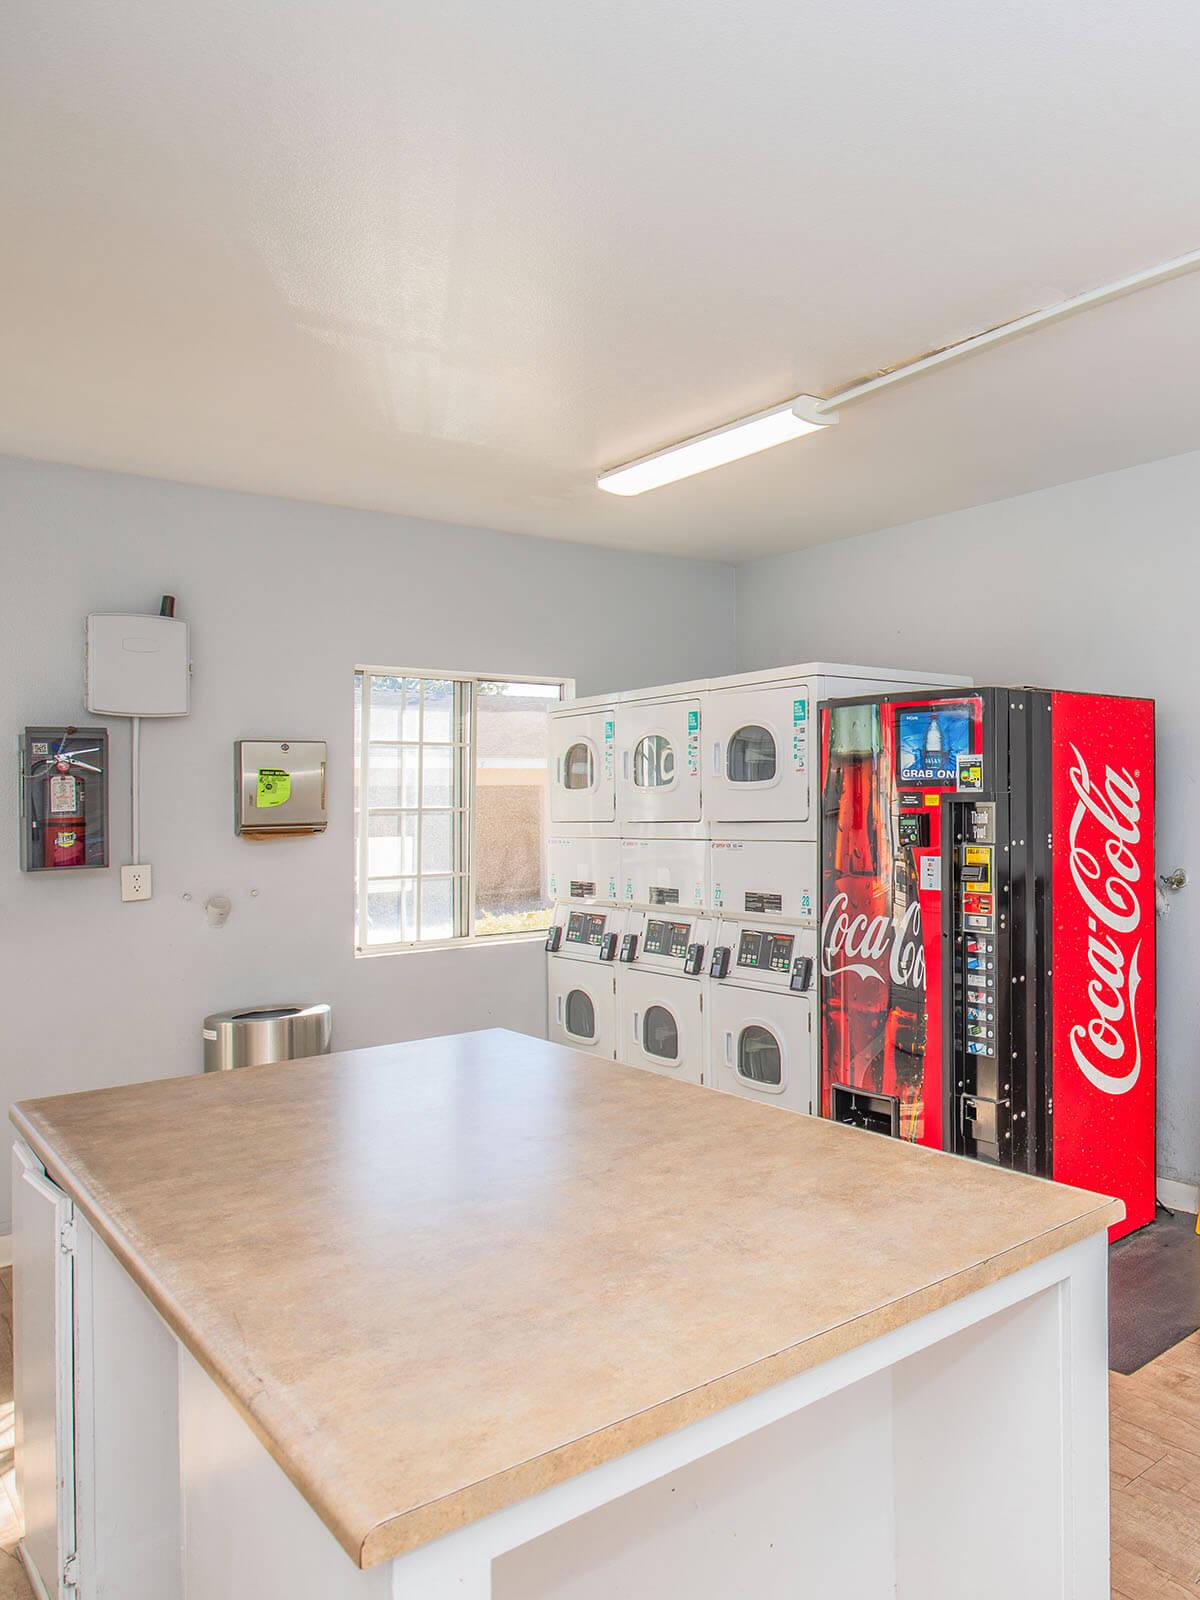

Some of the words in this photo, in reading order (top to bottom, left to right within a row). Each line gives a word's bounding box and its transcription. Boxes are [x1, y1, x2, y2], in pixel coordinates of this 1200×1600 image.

[902, 769, 934, 778] GRAB
[937, 769, 957, 779] ON
[802, 895, 810, 907] 28
[1069, 741, 1142, 1095] Coca-Cola
[821, 892, 927, 991] Coca-Co
